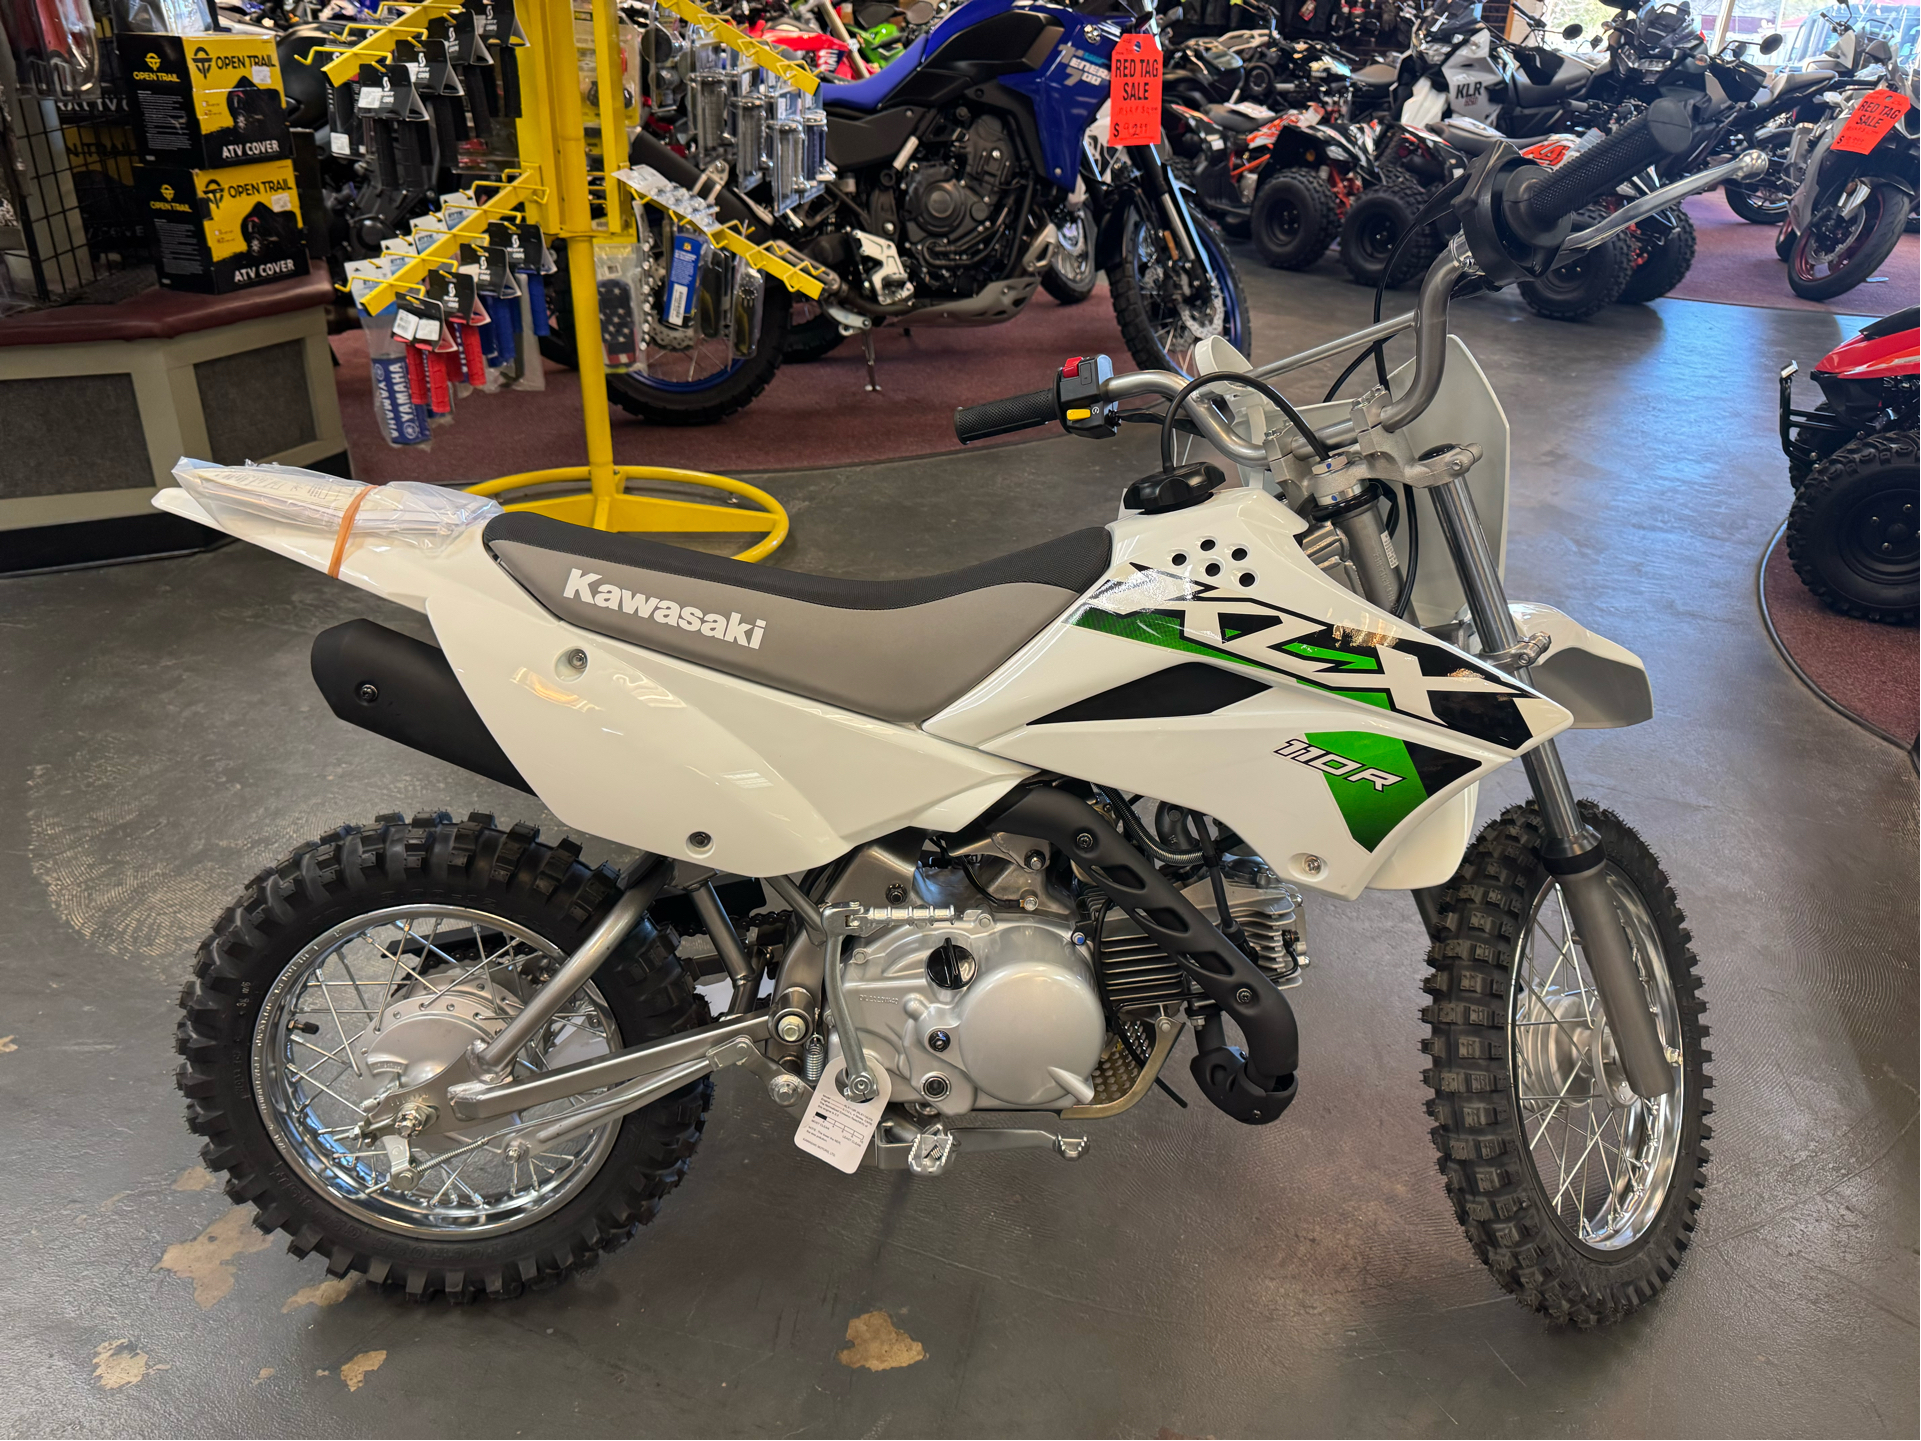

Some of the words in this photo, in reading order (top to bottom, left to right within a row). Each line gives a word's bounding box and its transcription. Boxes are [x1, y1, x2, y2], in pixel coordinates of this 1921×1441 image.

[216, 54, 246, 70] OPEN
[247, 54, 276, 68] TRAIL
[1115, 59, 1136, 78] RED
[1140, 58, 1159, 78] TAG
[132, 72, 158, 81] OPEN
[158, 72, 181, 82] TRAIL
[1063, 66, 1102, 86] 700
[1123, 82, 1149, 101] SALE
[1455, 81, 1483, 99] KLR
[1858, 101, 1880, 113] RED
[1879, 106, 1902, 120] TAG
[1113, 123, 1120, 138] $
[1855, 114, 1884, 129] SALE
[222, 145, 244, 159] ATV
[245, 139, 280, 155] COVER
[1836, 135, 1845, 145] $
[227, 183, 258, 198] OPEN
[261, 178, 293, 193] TRAIL
[150, 201, 172, 211] OPEN
[171, 203, 193, 213] TRAIL
[234, 268, 256, 283] ATV
[258, 259, 295, 277] COVER
[388, 362, 413, 422] YAMAHA
[378, 382, 399, 438] YAMAHA
[563, 568, 767, 650] Kawasaki
[1273, 738, 1407, 793] 110R
